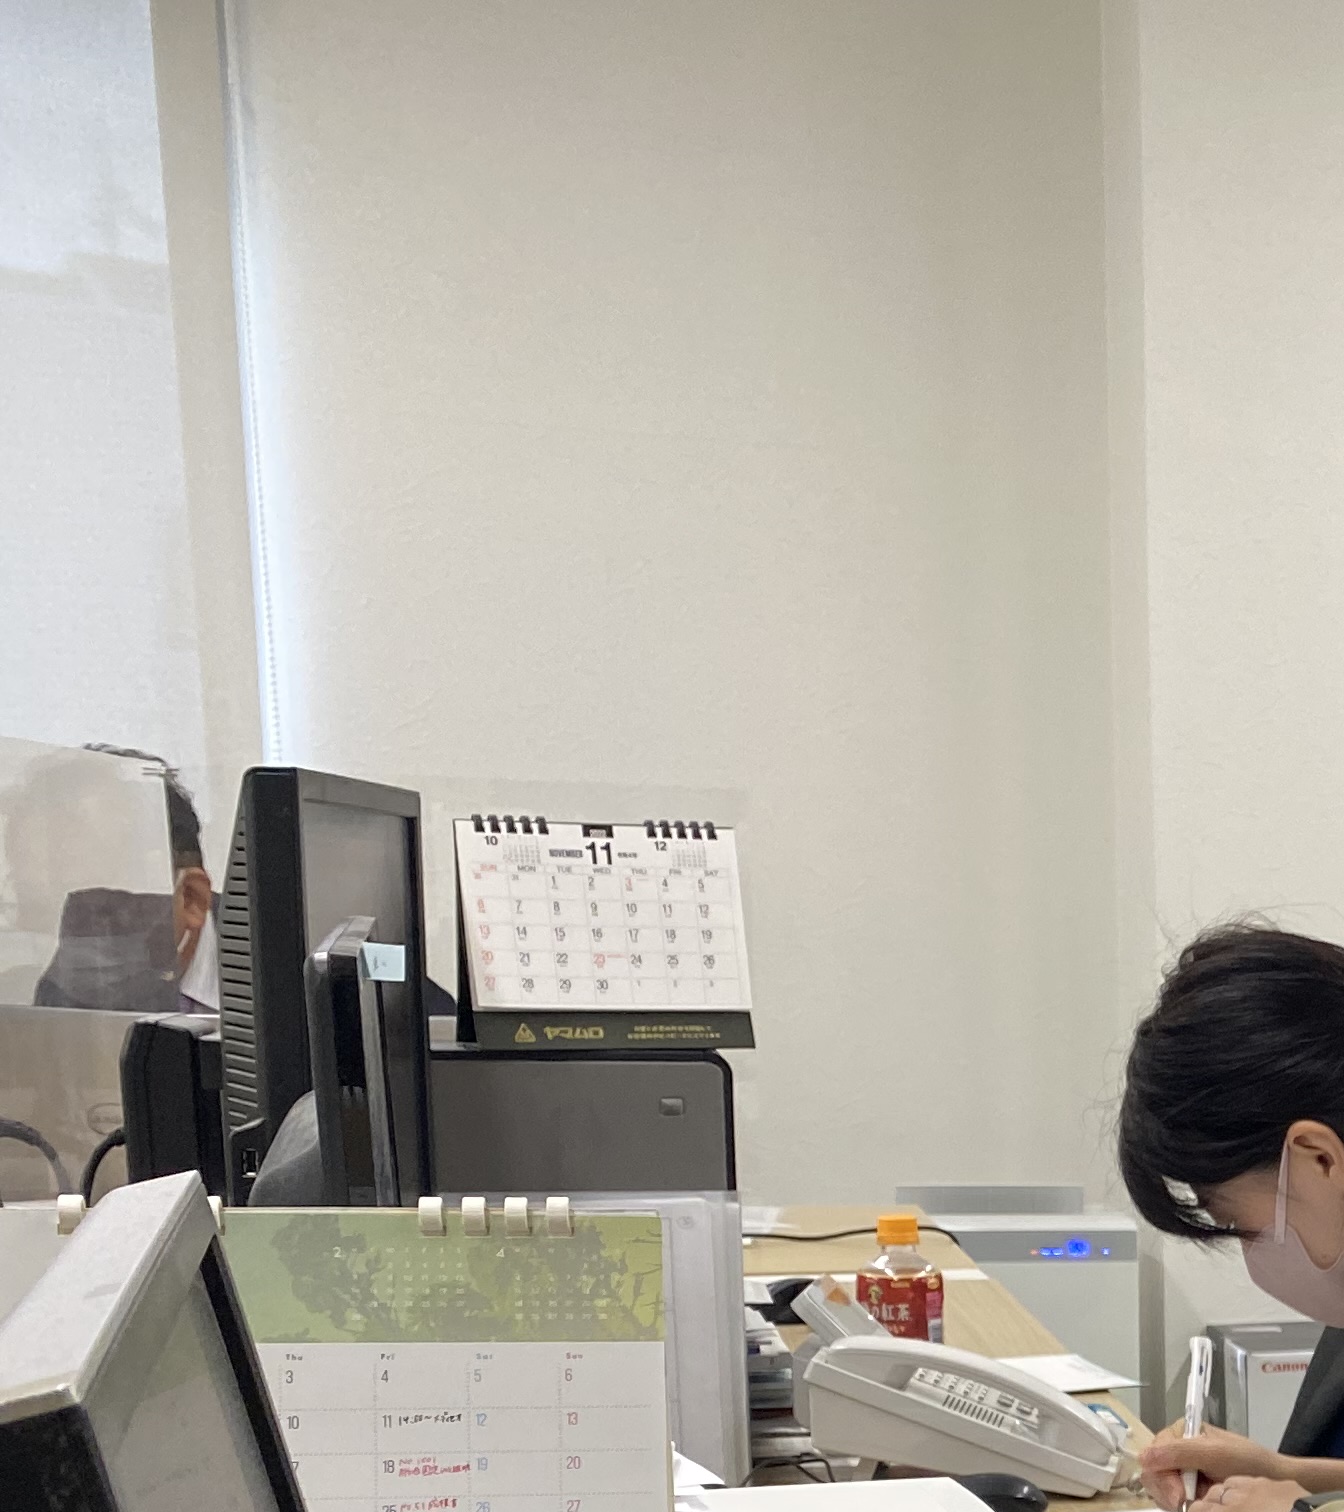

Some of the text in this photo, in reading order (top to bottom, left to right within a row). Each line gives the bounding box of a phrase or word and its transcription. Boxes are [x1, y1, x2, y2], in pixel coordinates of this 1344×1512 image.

[485, 835, 498, 846] 10
[549, 849, 583, 858] NOVEMBER
[585, 841, 613, 865] 11
[654, 841, 667, 851] 12
[517, 865, 536, 873] MON
[557, 865, 572, 873] TUE
[626, 903, 637, 913] 10
[663, 903, 672, 914] 11
[516, 926, 527, 937] 14
[554, 927, 566, 937] 15
[592, 928, 603, 938] 16
[629, 928, 639, 939] 17
[665, 929, 676, 939] 18
[702, 930, 712, 940] 19
[520, 952, 530, 963] 21
[556, 953, 568, 963] 22
[631, 954, 642, 965] 24
[667, 955, 679, 965] 25
[703, 955, 715, 966] 26
[522, 978, 534, 989] 28
[560, 979, 571, 989] 29
[597, 980, 608, 990] 30
[380, 1353, 395, 1361] Fri
[285, 1368, 573, 1385] 3 4 5 6
[287, 1415, 300, 1430] 10
[382, 1414, 392, 1428] 11
[476, 1413, 488, 1427] 12
[567, 1411, 579, 1426] 13
[383, 1460, 395, 1474] 18
[476, 1457, 488, 1471] 19
[566, 1456, 581, 1470] 20
